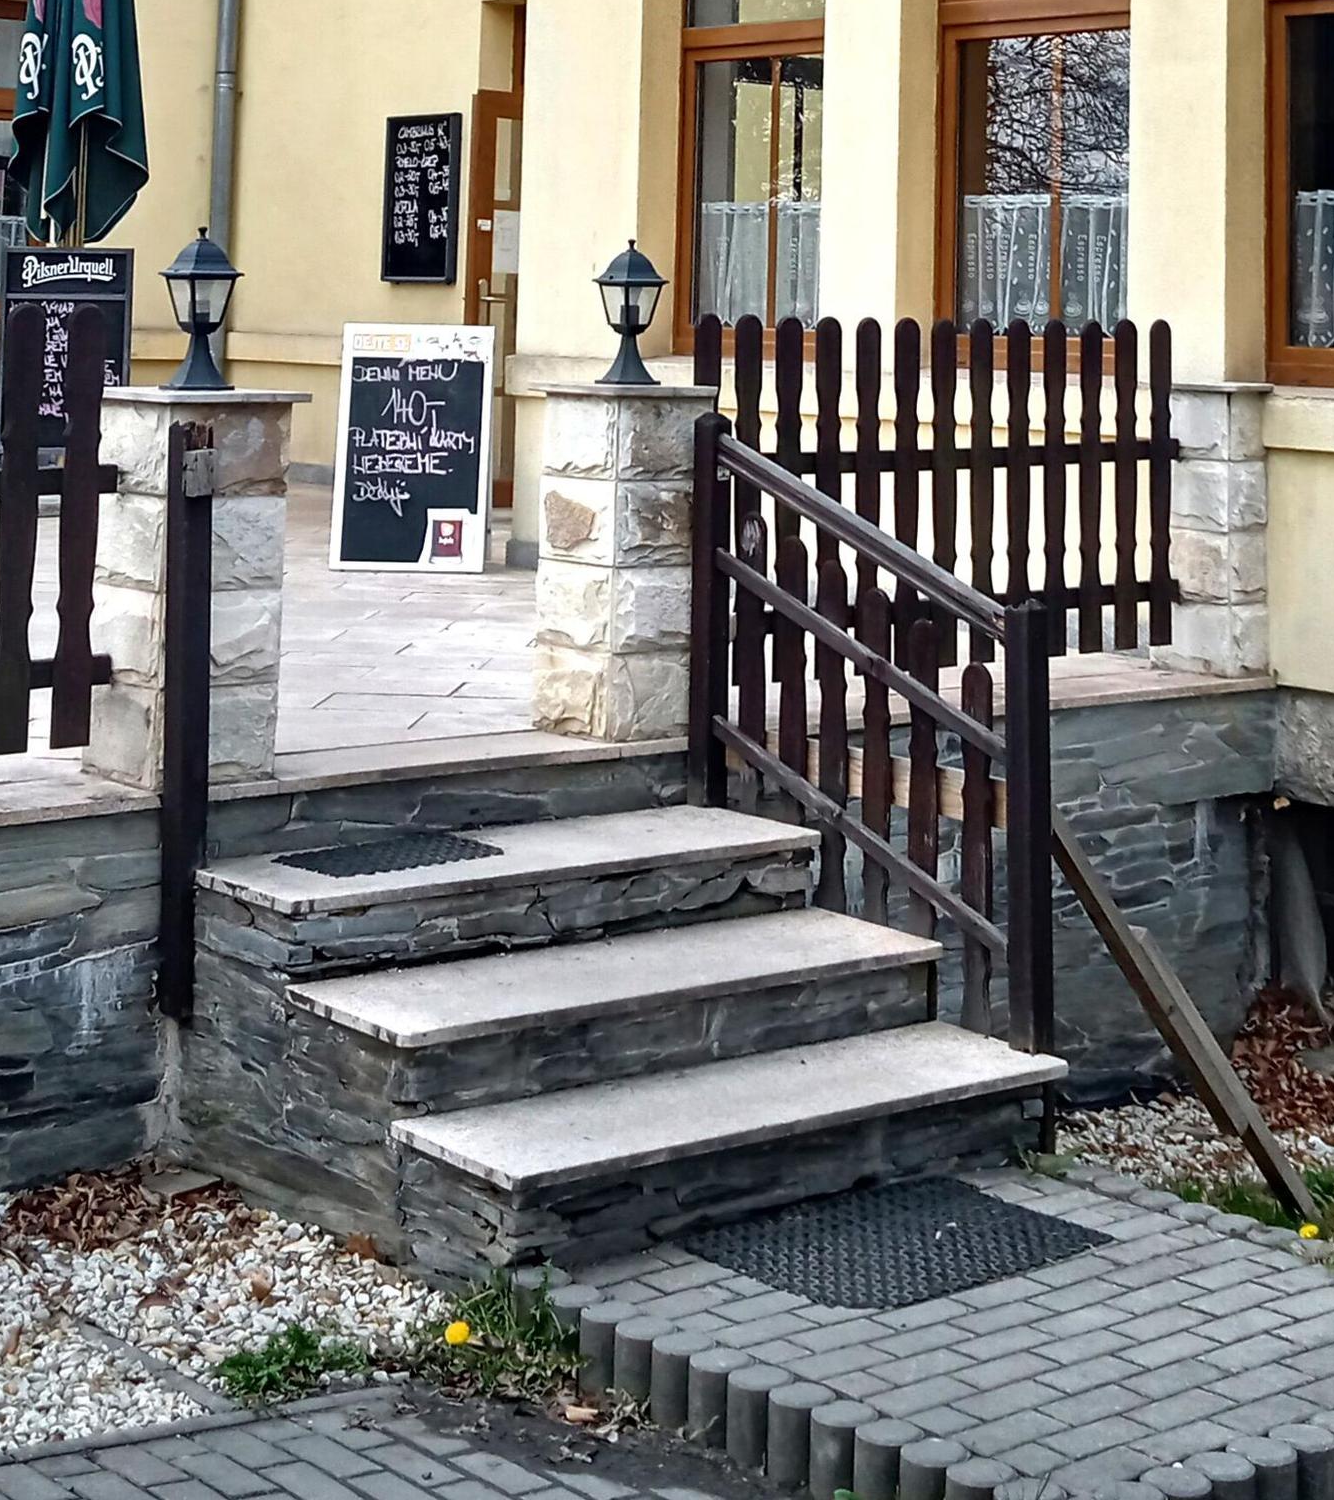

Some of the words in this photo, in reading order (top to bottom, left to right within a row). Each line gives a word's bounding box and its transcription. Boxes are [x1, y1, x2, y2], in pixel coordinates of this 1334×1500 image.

[22, 255, 69, 288] Pilsner
[68, 255, 115, 281] Urquell
[353, 358, 404, 382] DENNÍ
[408, 362, 458, 382] MENU
